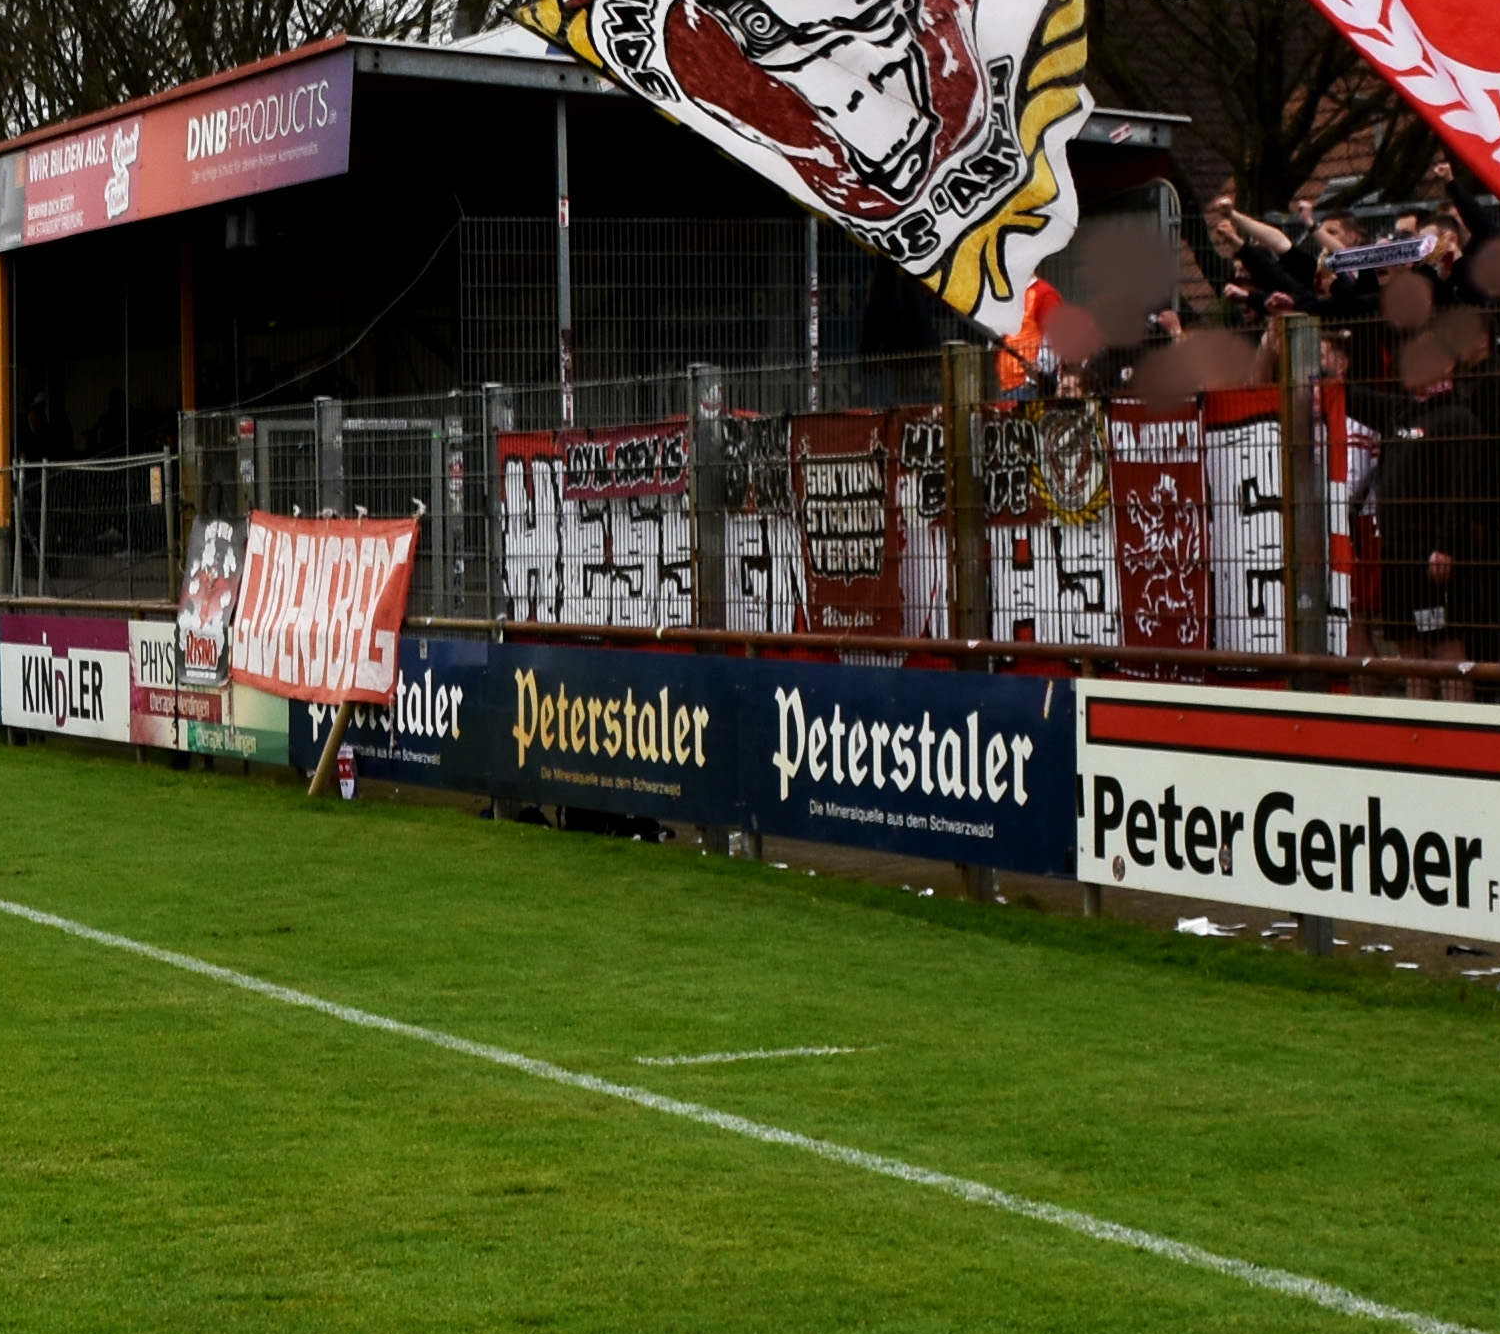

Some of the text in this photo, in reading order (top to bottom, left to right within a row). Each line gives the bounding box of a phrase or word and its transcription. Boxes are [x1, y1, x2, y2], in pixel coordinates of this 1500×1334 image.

[29, 133, 109, 183] WIR BILDEN AUS.
[21, 654, 105, 728] KINDLER
[513, 667, 710, 769] Peterstaler
[541, 765, 681, 798] Die Mineralquelle aus dem Schwarzwald
[772, 685, 1034, 807] Peterstaler
[809, 798, 994, 840] Die Mineralquelle aus dem Schwarzwald
[1093, 772, 1483, 911] Peter Gerber
